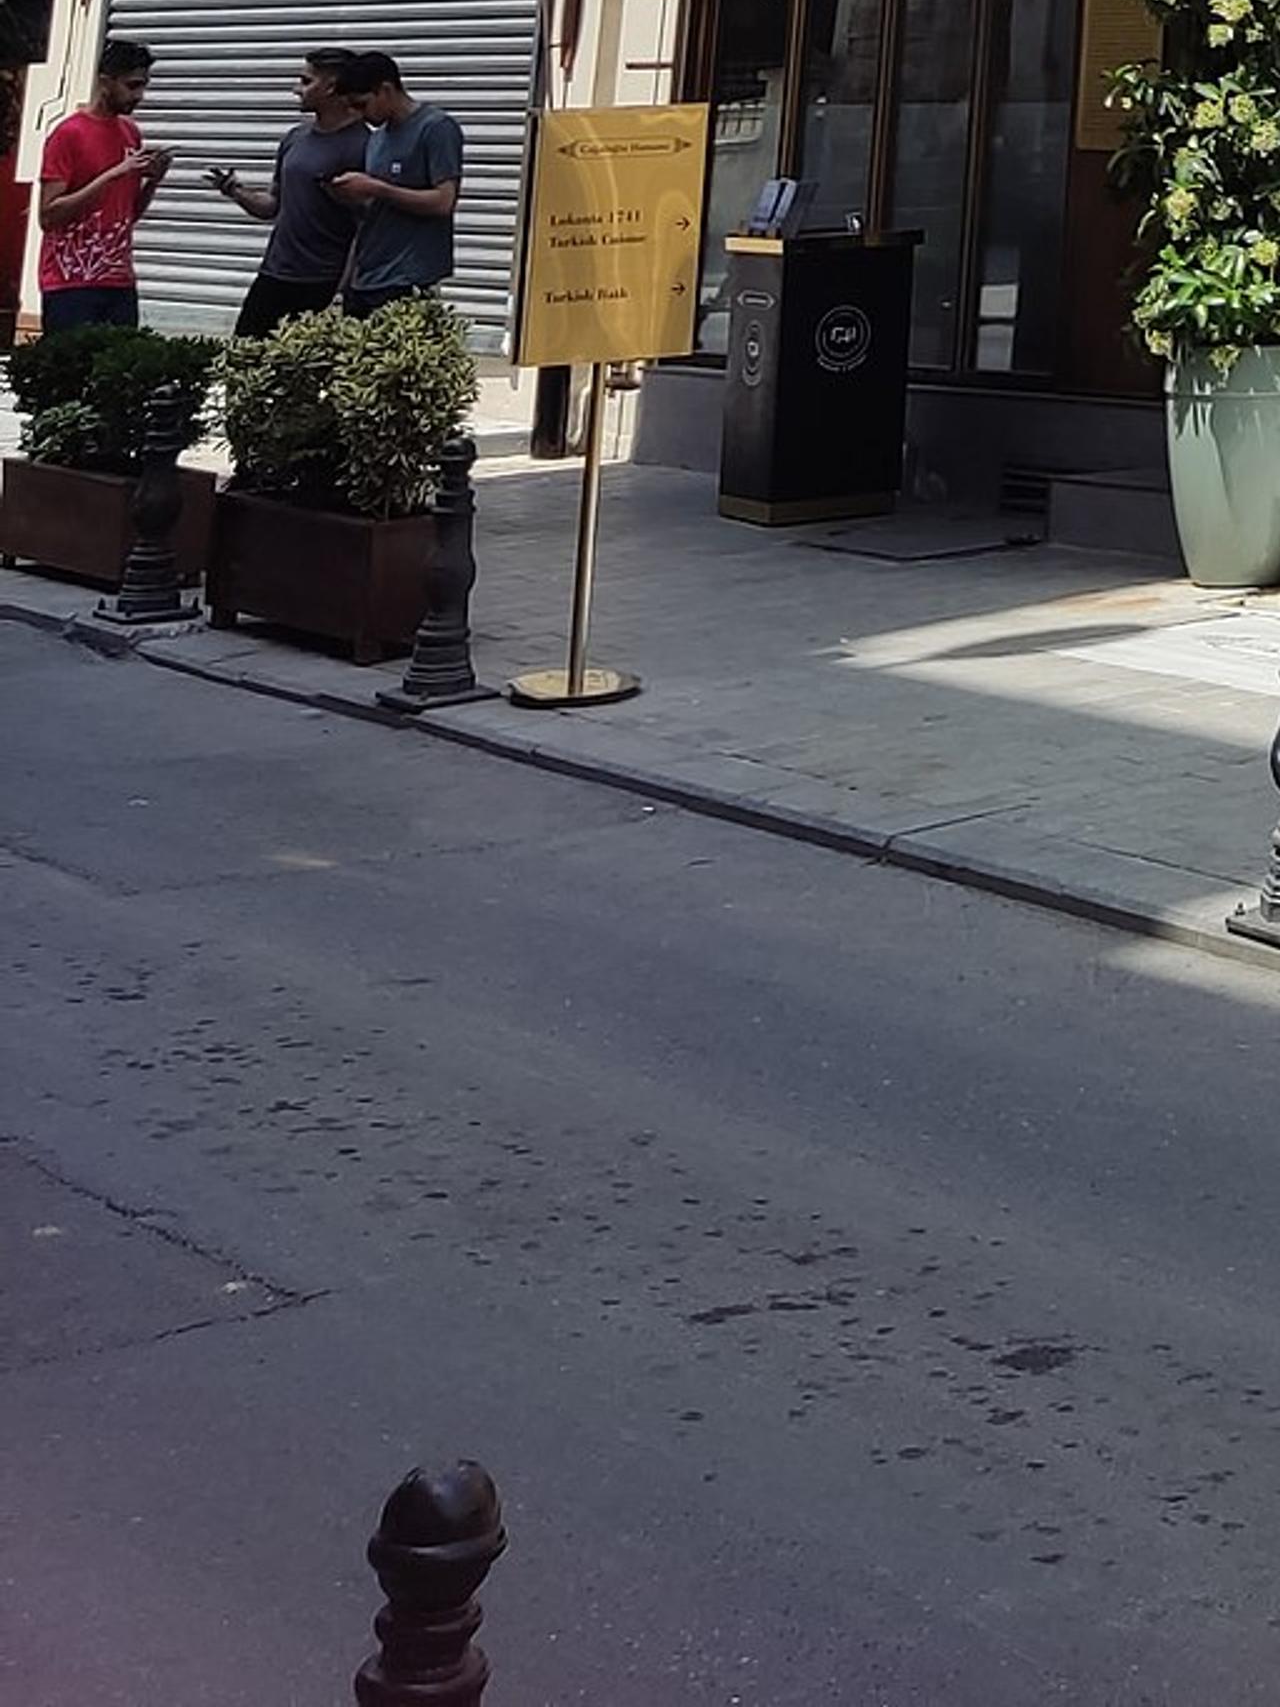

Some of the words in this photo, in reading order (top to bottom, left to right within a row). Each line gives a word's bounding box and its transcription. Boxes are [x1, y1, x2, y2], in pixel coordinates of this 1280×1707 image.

[609, 209, 641, 223] 1741
[549, 234, 598, 248] Turkish
[545, 289, 594, 303] Turkish
